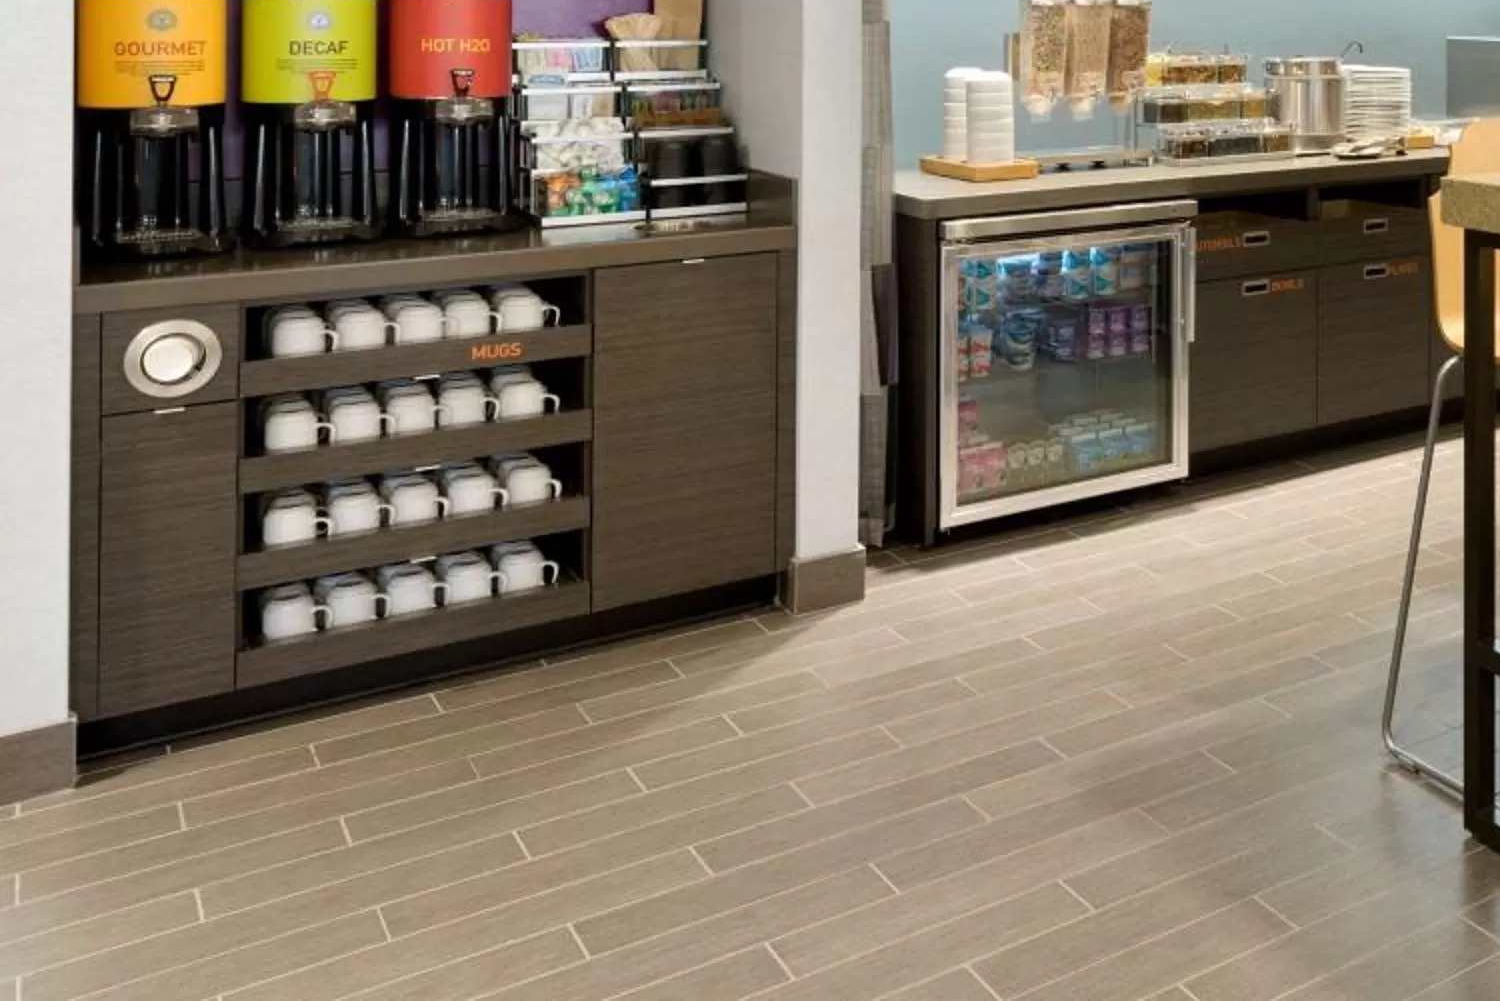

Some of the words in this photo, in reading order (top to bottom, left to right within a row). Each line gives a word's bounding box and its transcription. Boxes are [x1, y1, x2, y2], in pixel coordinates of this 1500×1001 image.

[114, 40, 207, 57] GOURMET
[289, 40, 349, 56] DECAF
[420, 38, 456, 53] HOT
[471, 342, 523, 360] MUGS
